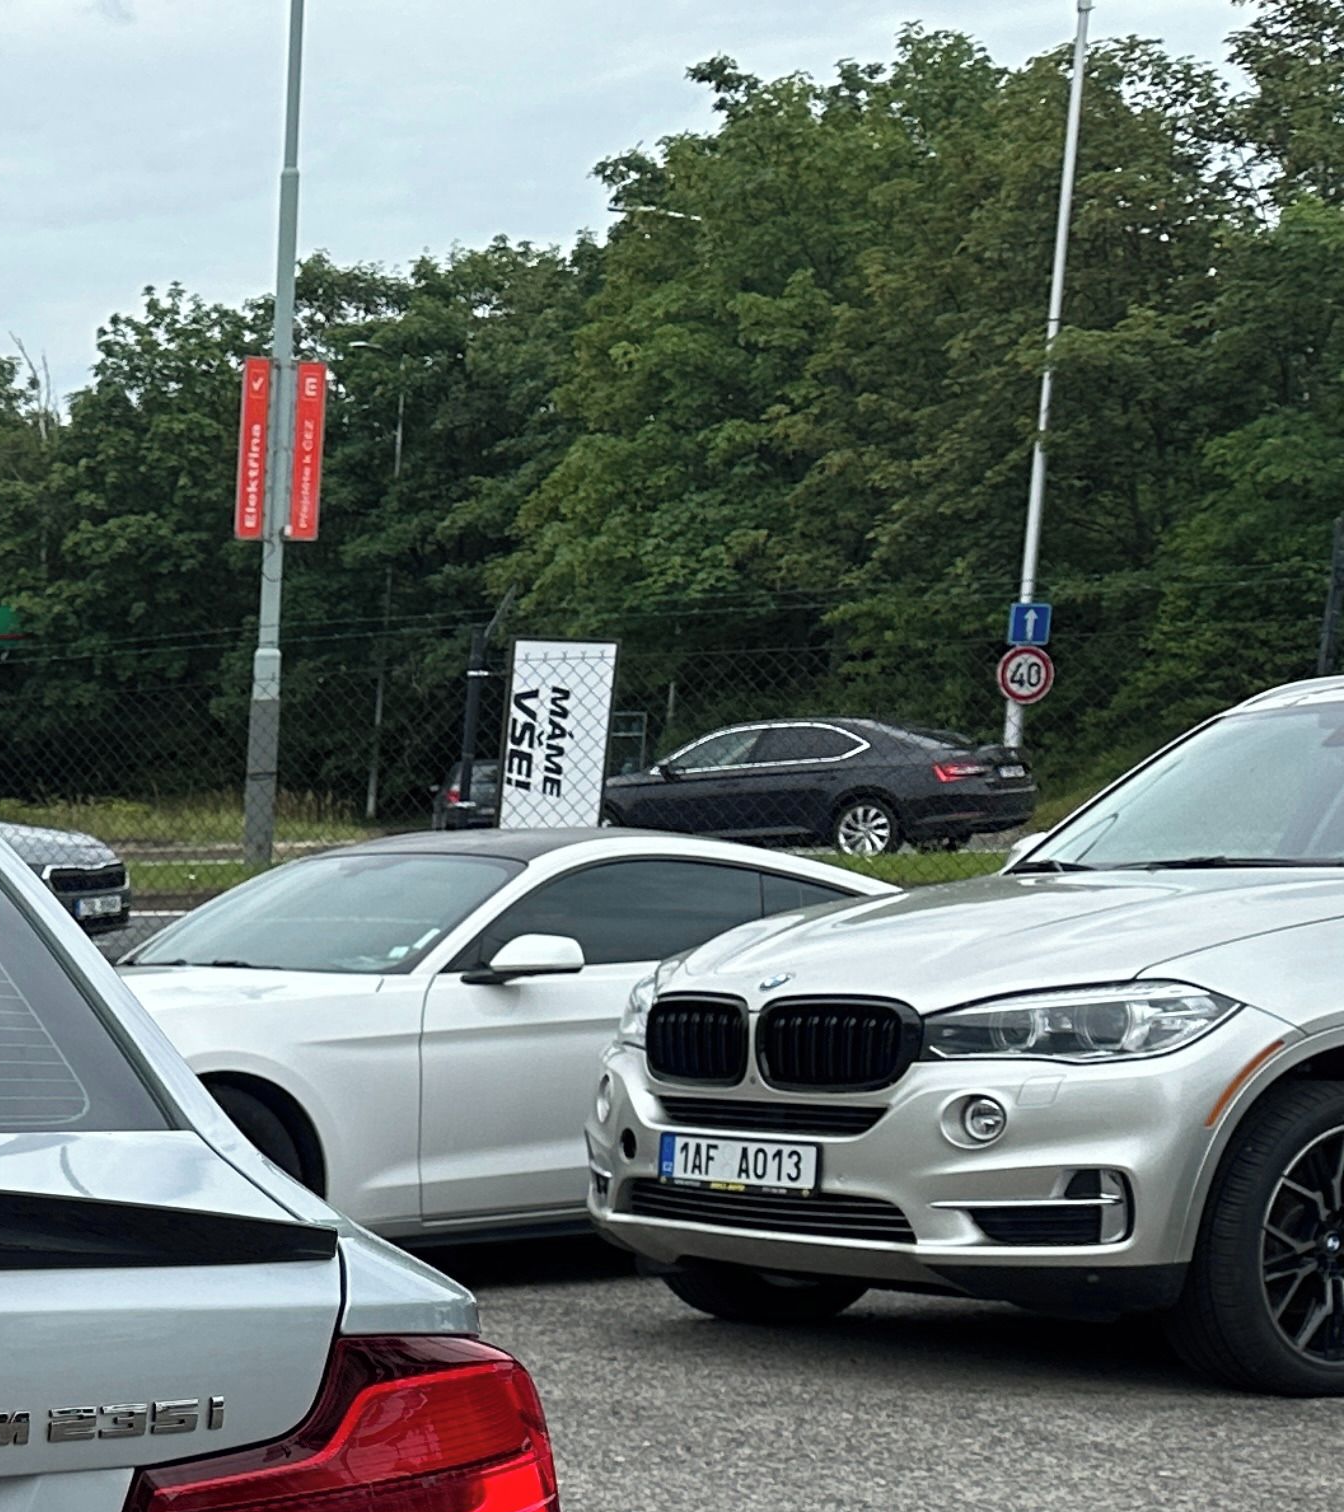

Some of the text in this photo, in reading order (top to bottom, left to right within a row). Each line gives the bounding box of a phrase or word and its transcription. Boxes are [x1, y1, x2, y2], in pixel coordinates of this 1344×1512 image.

[244, 424, 262, 528] Elektřina
[1010, 662, 1041, 688] 40
[506, 688, 545, 791] VŠE!
[542, 686, 574, 798] MÁME
[680, 1141, 802, 1182] 1AF A013
